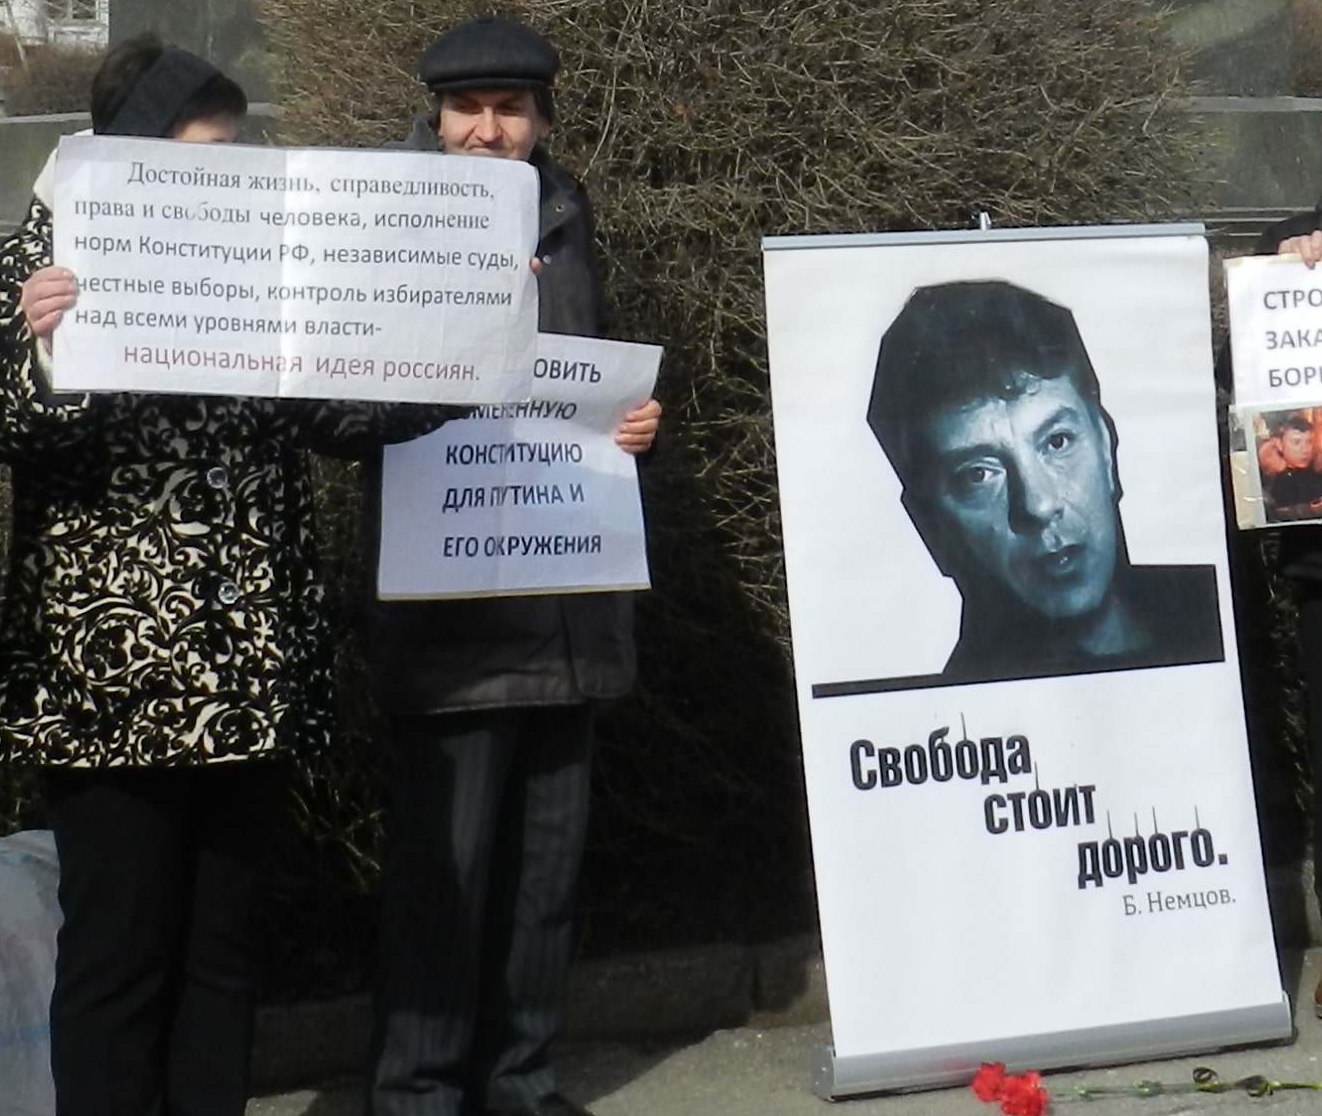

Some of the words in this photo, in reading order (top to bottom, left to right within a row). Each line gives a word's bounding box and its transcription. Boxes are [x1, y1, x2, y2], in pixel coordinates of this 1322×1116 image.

[127, 161, 241, 189] Достойная
[248, 175, 321, 195] жизнь,
[329, 176, 495, 200] справедливость,
[74, 200, 135, 221] права
[142, 204, 154, 218] и
[161, 201, 251, 224] свободы
[260, 211, 367, 230] человека,
[374, 212, 490, 229] исполнение
[74, 235, 132, 256] норм
[138, 235, 272, 264] Конституции
[279, 243, 316, 266] РФ,
[323, 248, 463, 266] независимые
[467, 251, 519, 271] суды,
[77, 276, 165, 295] честные
[171, 277, 260, 303] выборы,
[267, 285, 367, 306] контроль
[373, 284, 513, 308] избирателями
[75, 309, 118, 329] над
[123, 310, 188, 329] всеми
[193, 313, 297, 334] уровнями
[304, 319, 382, 336] власти-
[124, 345, 303, 372] национальная
[315, 357, 376, 380] идея
[383, 359, 480, 382] россиян.
[533, 358, 602, 383] ОВИТЬ
[467, 398, 577, 420] МЕНЕННУЮ
[445, 442, 583, 467] КОНСТИТУЦИЮ
[442, 487, 485, 514] ДЛЯ
[489, 484, 564, 508] ПУТИНА
[570, 483, 585, 502] И
[443, 536, 479, 558] ЕГО
[484, 534, 602, 558] ОКРУЖЕНИЯ
[849, 714, 1033, 791] Свобода
[983, 774, 1097, 835] стоит
[1077, 819, 1229, 890] дорого.
[1123, 894, 1143, 917] Б.
[1147, 888, 1238, 914] Немцов.
